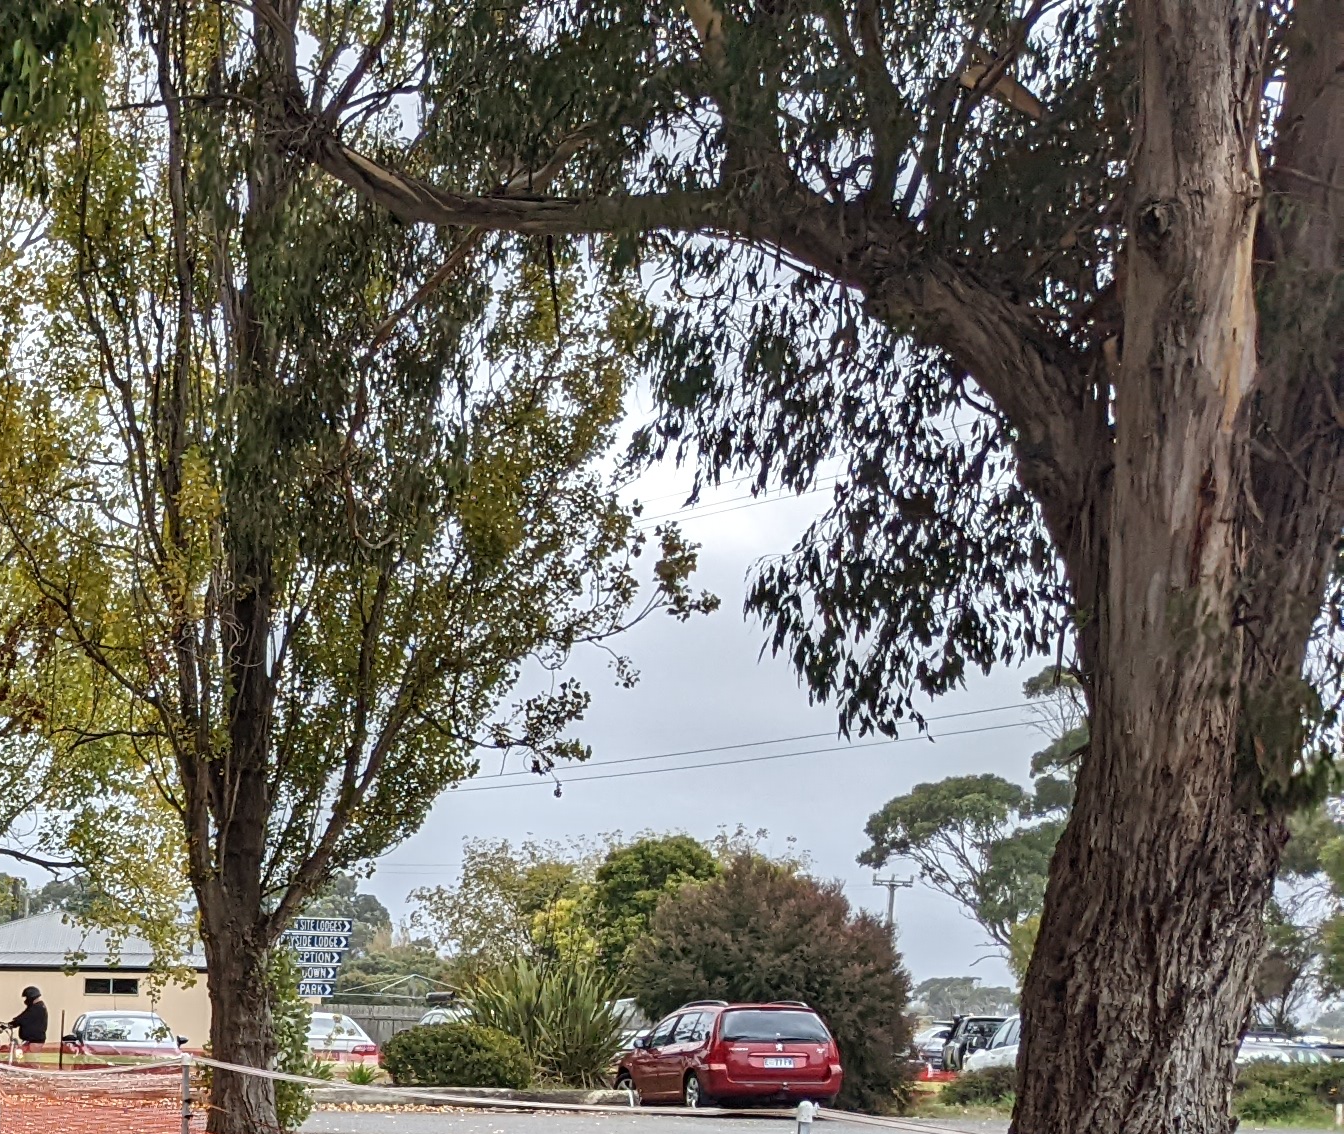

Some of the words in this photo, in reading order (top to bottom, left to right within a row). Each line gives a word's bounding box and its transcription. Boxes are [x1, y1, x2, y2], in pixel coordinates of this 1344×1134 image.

[300, 919, 315, 931] SITE
[316, 920, 343, 932] LODGES
[314, 936, 338, 948] LODGE
[298, 951, 331, 963] EPTION
[299, 984, 323, 995] PARK
